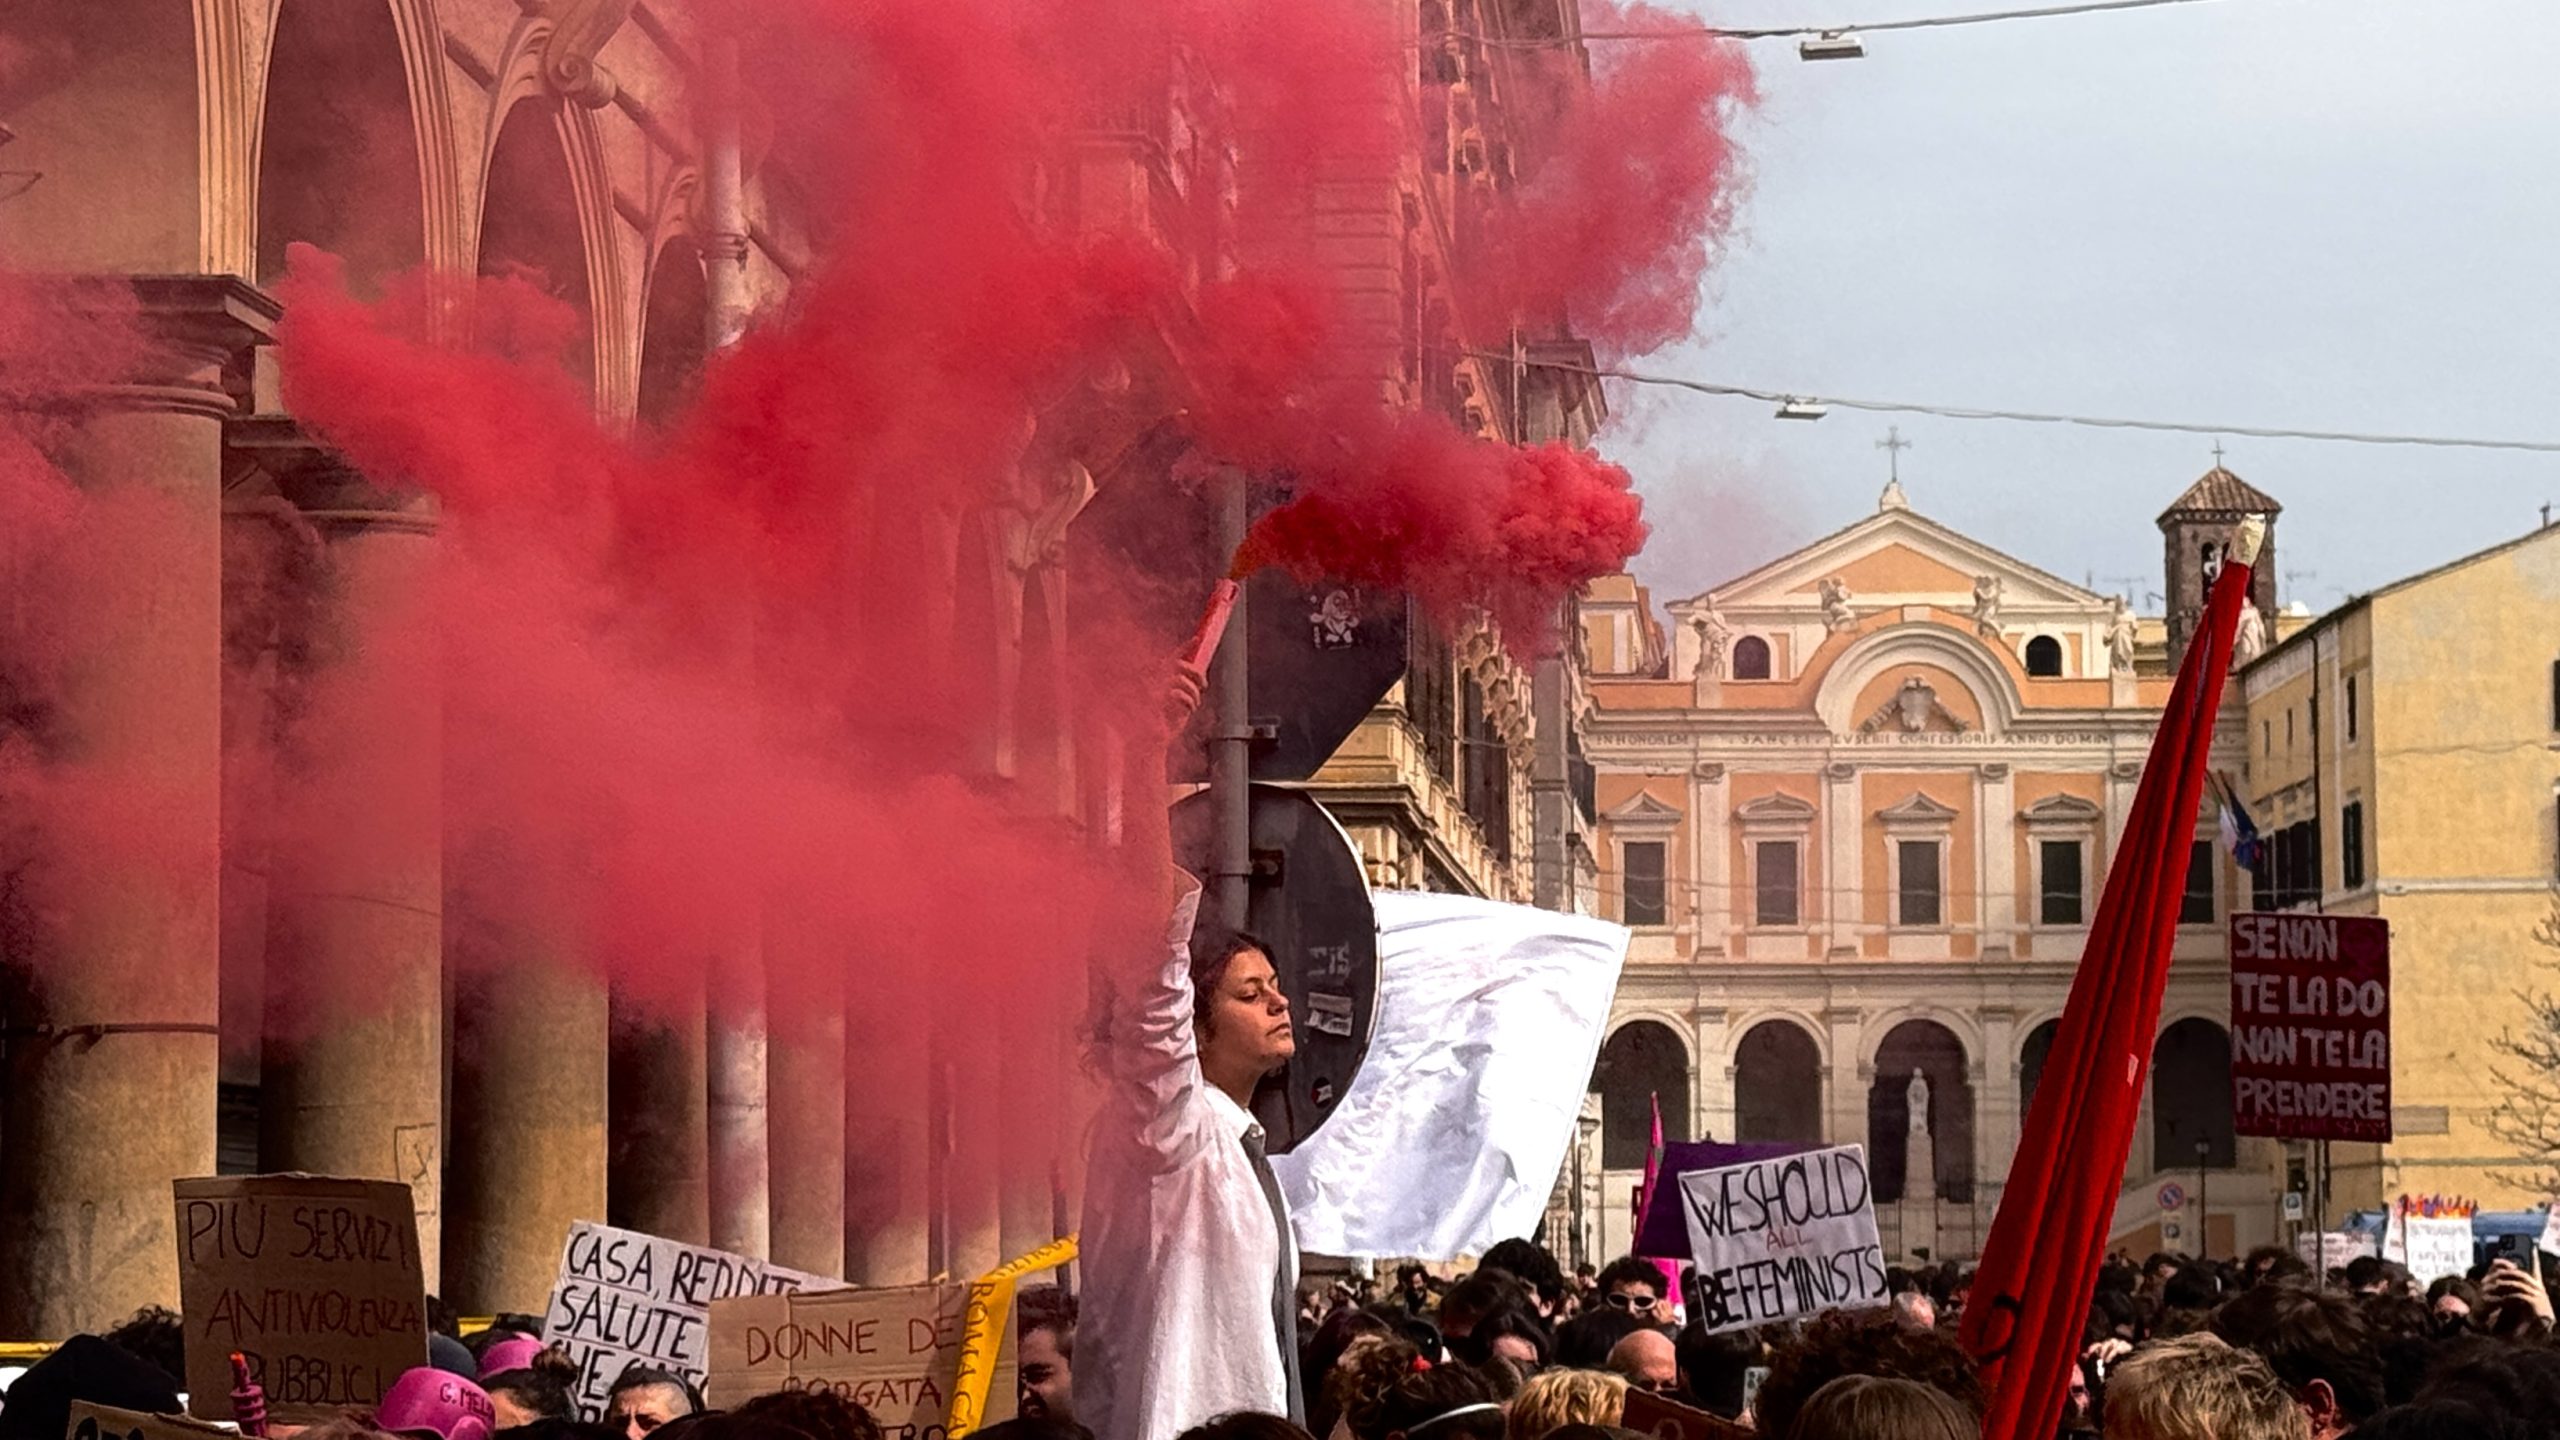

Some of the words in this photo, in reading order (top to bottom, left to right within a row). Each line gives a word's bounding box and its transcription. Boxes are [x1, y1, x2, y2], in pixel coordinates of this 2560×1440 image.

[2233, 972, 2281, 1014] TE
[2288, 975, 2328, 1016] LA
[2336, 977, 2386, 1018] DO
[2232, 1025, 2298, 1065] NON
[2301, 1028, 2344, 1067] TE
[2348, 1029, 2386, 1069] LA
[2235, 1077, 2387, 1120] PRENDERE
[290, 1206, 408, 1270] SERVIZI
[1766, 1228, 1813, 1251] ALL
[205, 1287, 422, 1345] ANTIVIOLENZA
[553, 1285, 703, 1359] SALUTE
[957, 1282, 996, 1380] ROMA
[746, 1319, 880, 1367] DONNE
